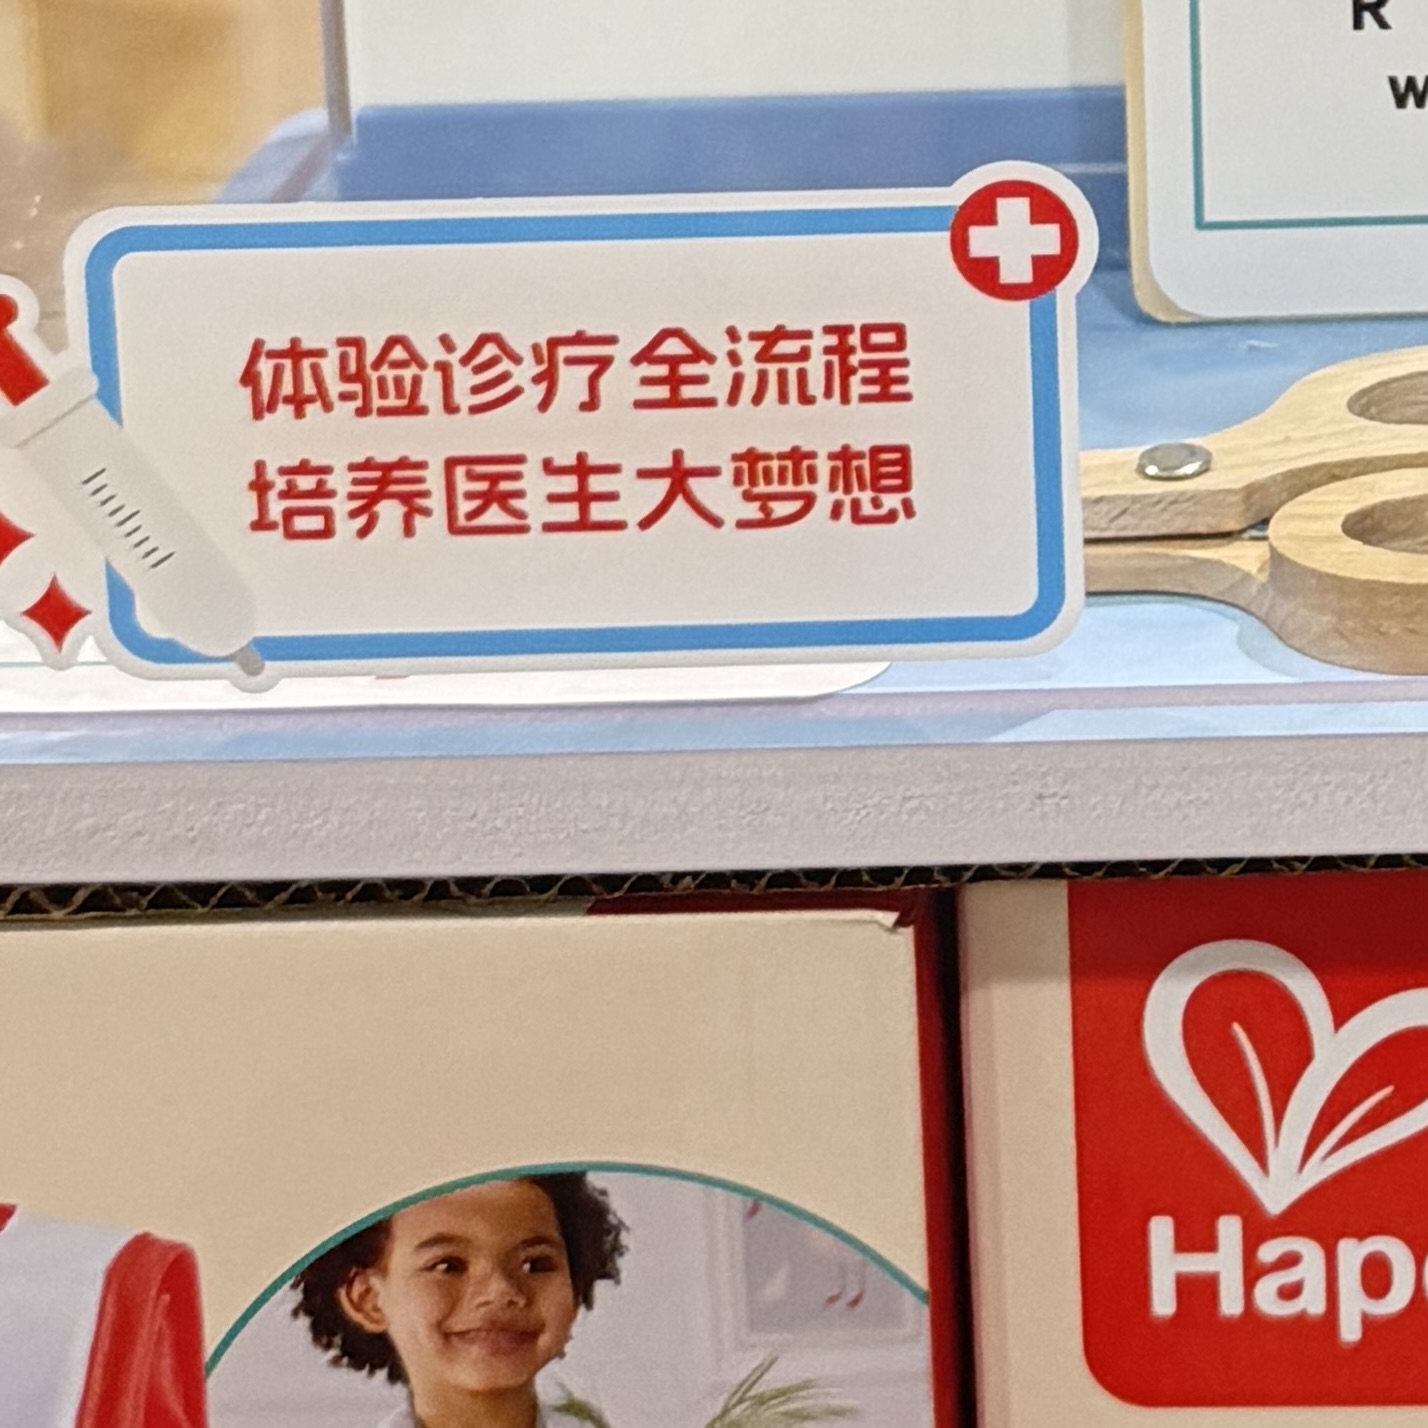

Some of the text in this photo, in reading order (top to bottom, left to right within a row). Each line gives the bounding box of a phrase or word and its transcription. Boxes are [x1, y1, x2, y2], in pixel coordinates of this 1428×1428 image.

[238, 321, 914, 422] 体验诊疗全流程
[247, 443, 917, 541] 培养医生大梦想
